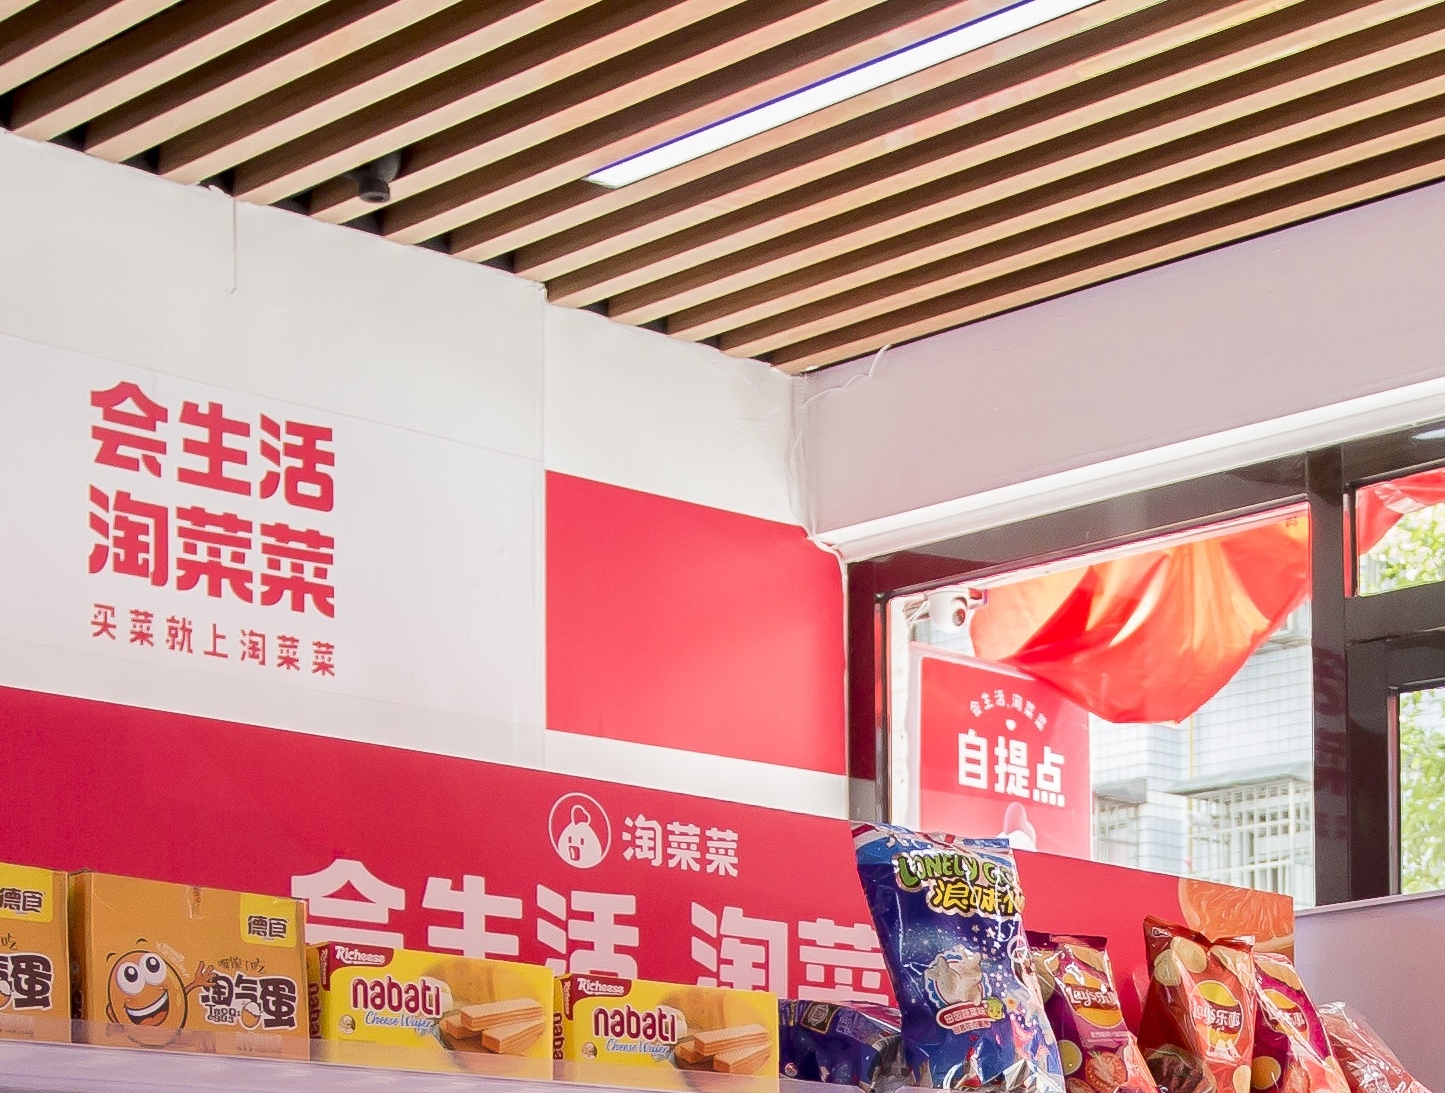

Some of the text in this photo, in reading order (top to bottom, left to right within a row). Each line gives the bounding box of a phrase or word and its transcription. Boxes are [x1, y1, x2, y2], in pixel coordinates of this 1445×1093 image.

[91, 380, 334, 512] 会生活
[88, 484, 334, 618] 淘菜菜
[91, 603, 335, 677] 买菜就上淘菜菜
[958, 728, 1065, 807] 自提点
[621, 813, 739, 877] 淘菜菜
[898, 851, 978, 889] LONELY
[335, 945, 386, 964] Richeese
[200, 974, 297, 1028] 淘气蛋
[352, 976, 442, 1016] nabati
[577, 977, 625, 995] Richeese
[594, 1005, 677, 1042] nabati
